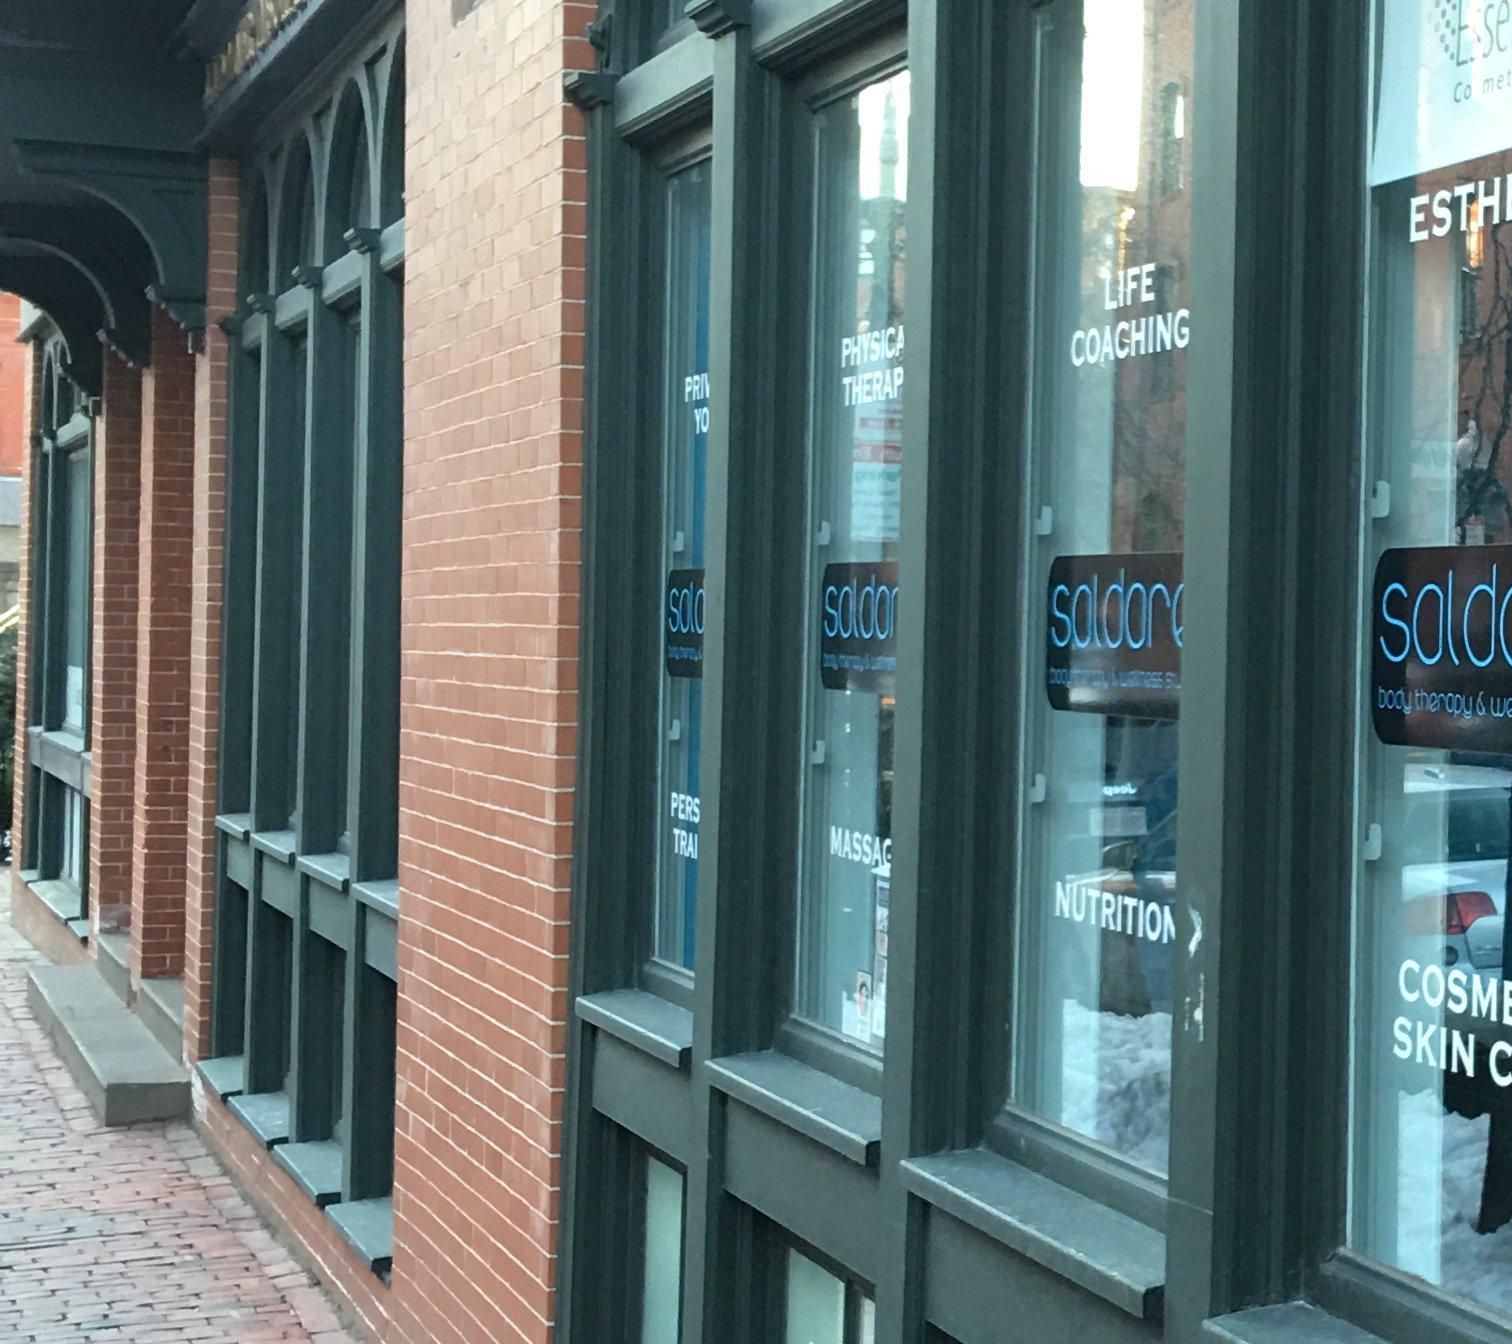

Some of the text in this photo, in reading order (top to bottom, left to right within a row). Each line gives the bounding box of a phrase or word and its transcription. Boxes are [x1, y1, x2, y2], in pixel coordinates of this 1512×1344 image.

[1104, 262, 1156, 311] LIFE
[1070, 308, 1190, 367] COACHING
[1393, 1016, 1475, 1078] SKIN
